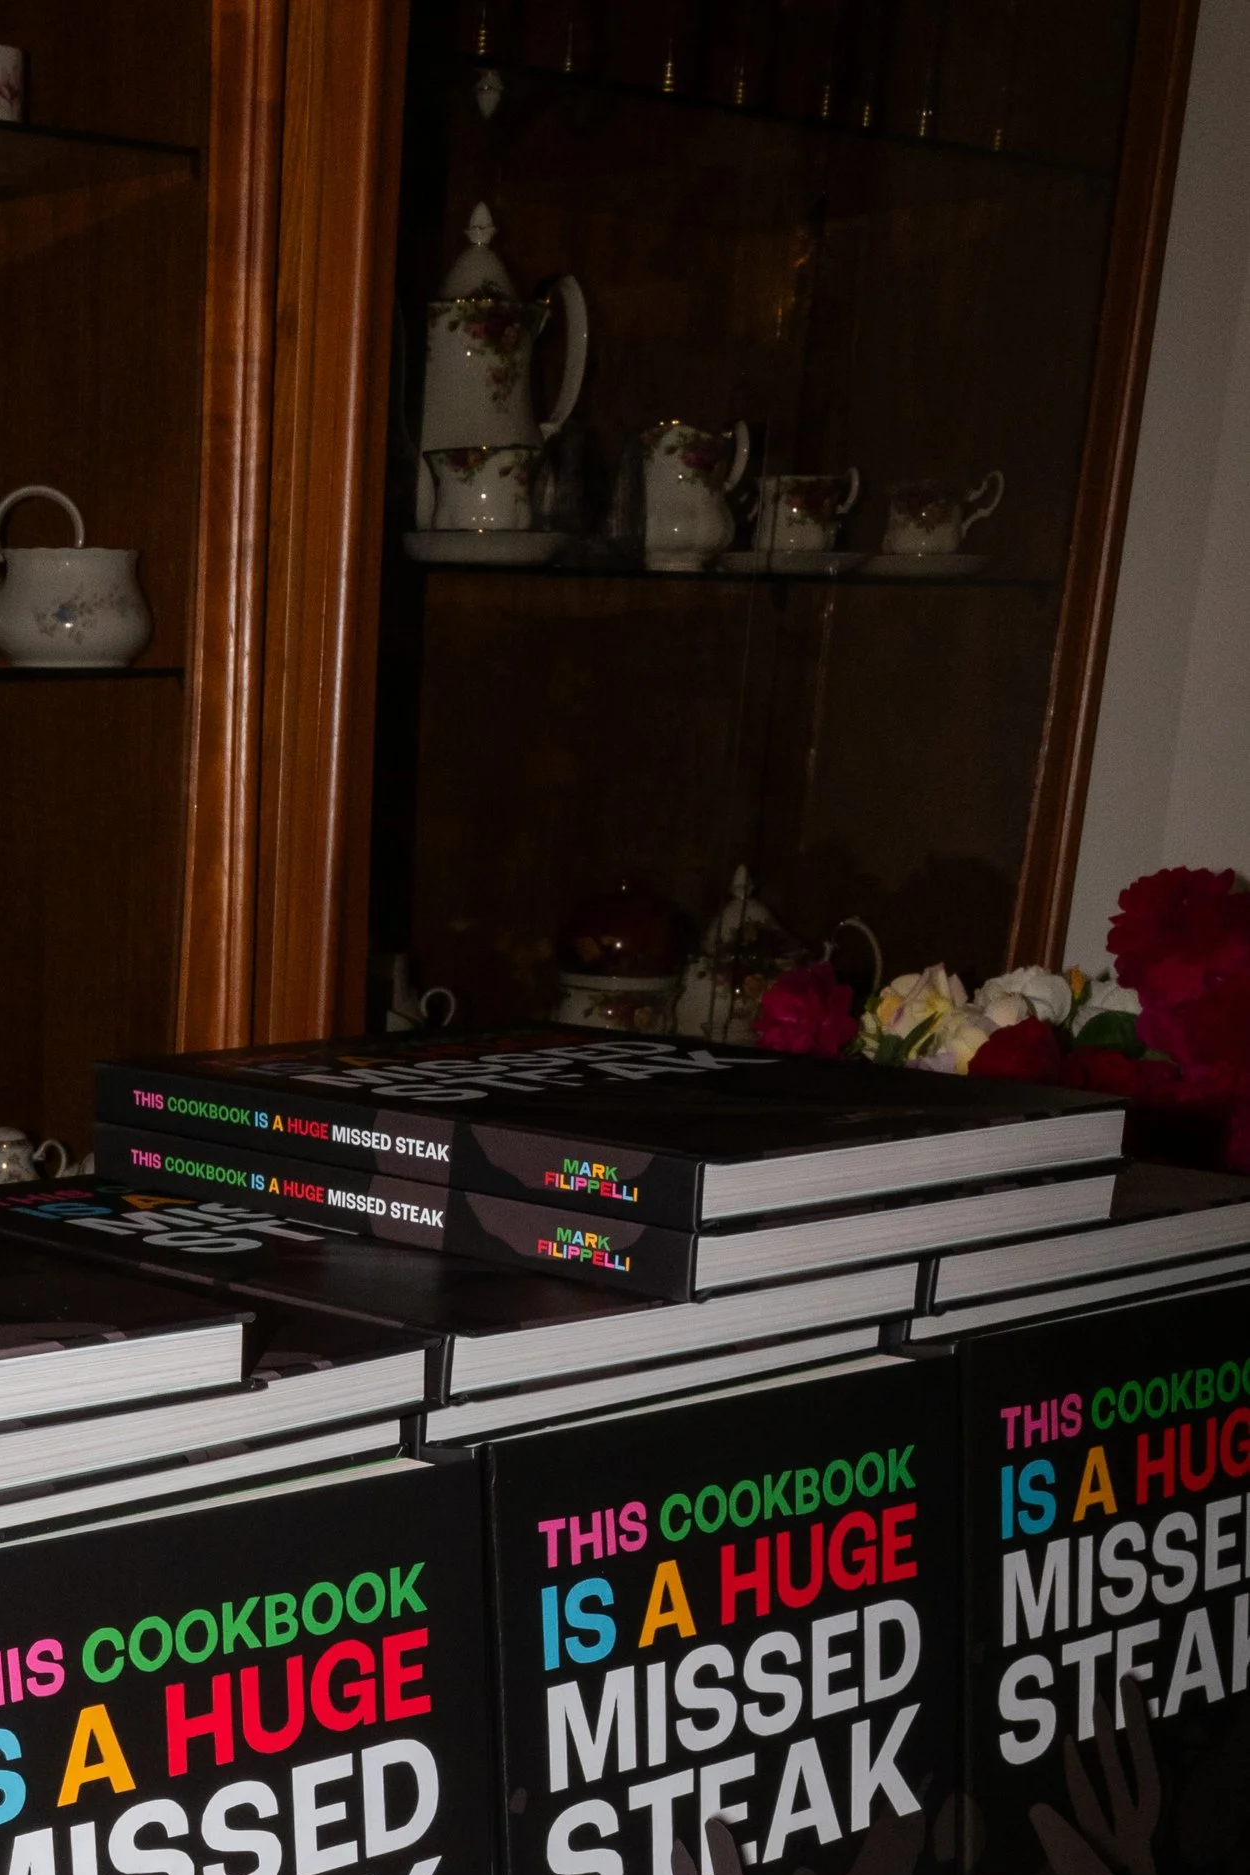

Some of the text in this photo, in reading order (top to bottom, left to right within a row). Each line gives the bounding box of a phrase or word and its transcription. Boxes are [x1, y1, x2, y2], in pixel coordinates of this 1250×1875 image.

[289, 1041, 678, 1088] MISSED
[132, 1089, 450, 1163] THIS COOKBOOK IS A HUGE MISSED STEAK
[9, 1202, 114, 1220] IS
[130, 1148, 445, 1228] THIS COOKBOOK IS A HUGE MISSED STEAK
[544, 1171, 638, 1203] FILIPPELLI
[563, 1158, 618, 1182] MARK
[537, 1239, 631, 1272] FILIPPELLI
[556, 1226, 611, 1252] MARK
[999, 1357, 1250, 1451] THIS COOKBO
[538, 1444, 918, 1568] THIS COOKBOOK
[1000, 1459, 1057, 1540] IS
[1072, 1444, 1118, 1523] A
[541, 1501, 918, 1671] IS A HUGE
[1002, 1491, 1250, 1648] MISSE
[82, 1561, 429, 1684] COOKBOOK
[57, 1703, 137, 1808] A
[165, 1627, 433, 1778] HUGE
[547, 1599, 922, 1792] MISSED
